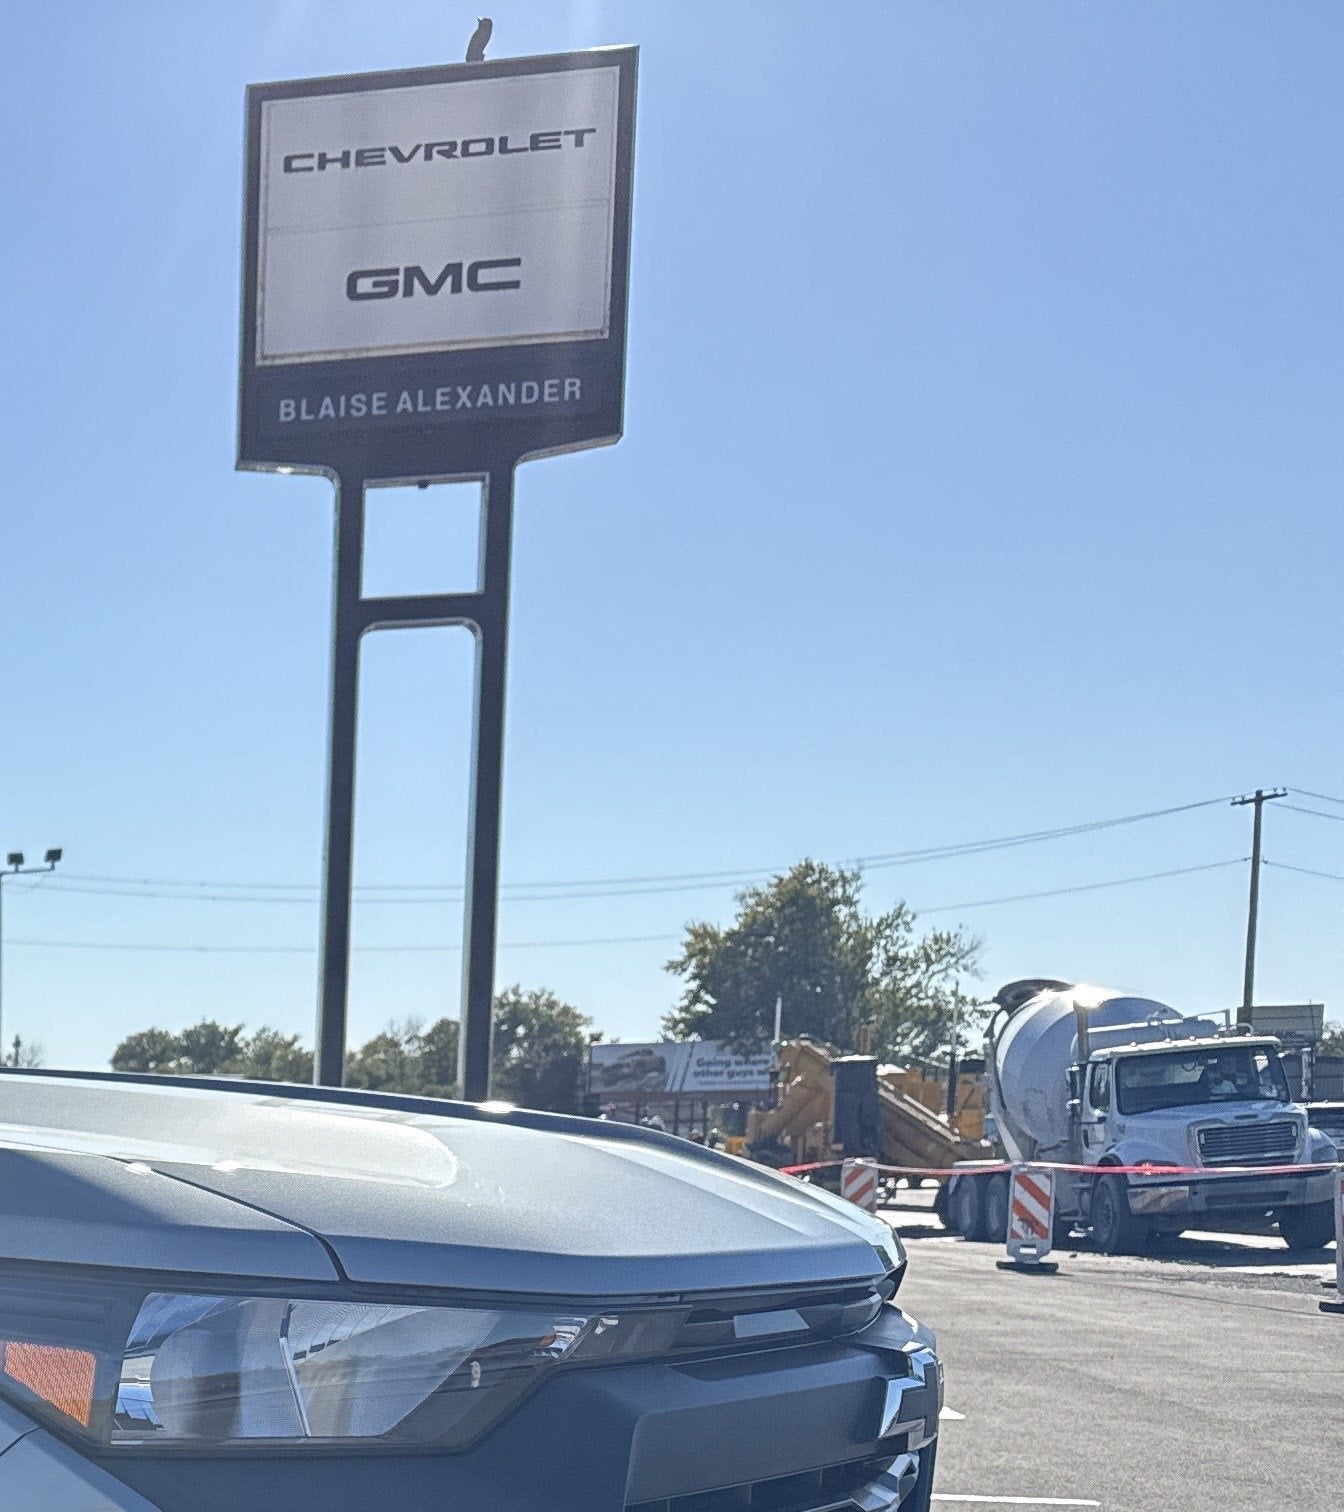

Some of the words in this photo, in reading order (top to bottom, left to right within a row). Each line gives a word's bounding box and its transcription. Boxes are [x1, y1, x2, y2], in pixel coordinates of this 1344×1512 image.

[283, 128, 597, 173] CHEVROLET
[346, 257, 522, 300] GMC
[279, 392, 388, 423] BLAISE
[396, 377, 582, 414] ALEXANDER
